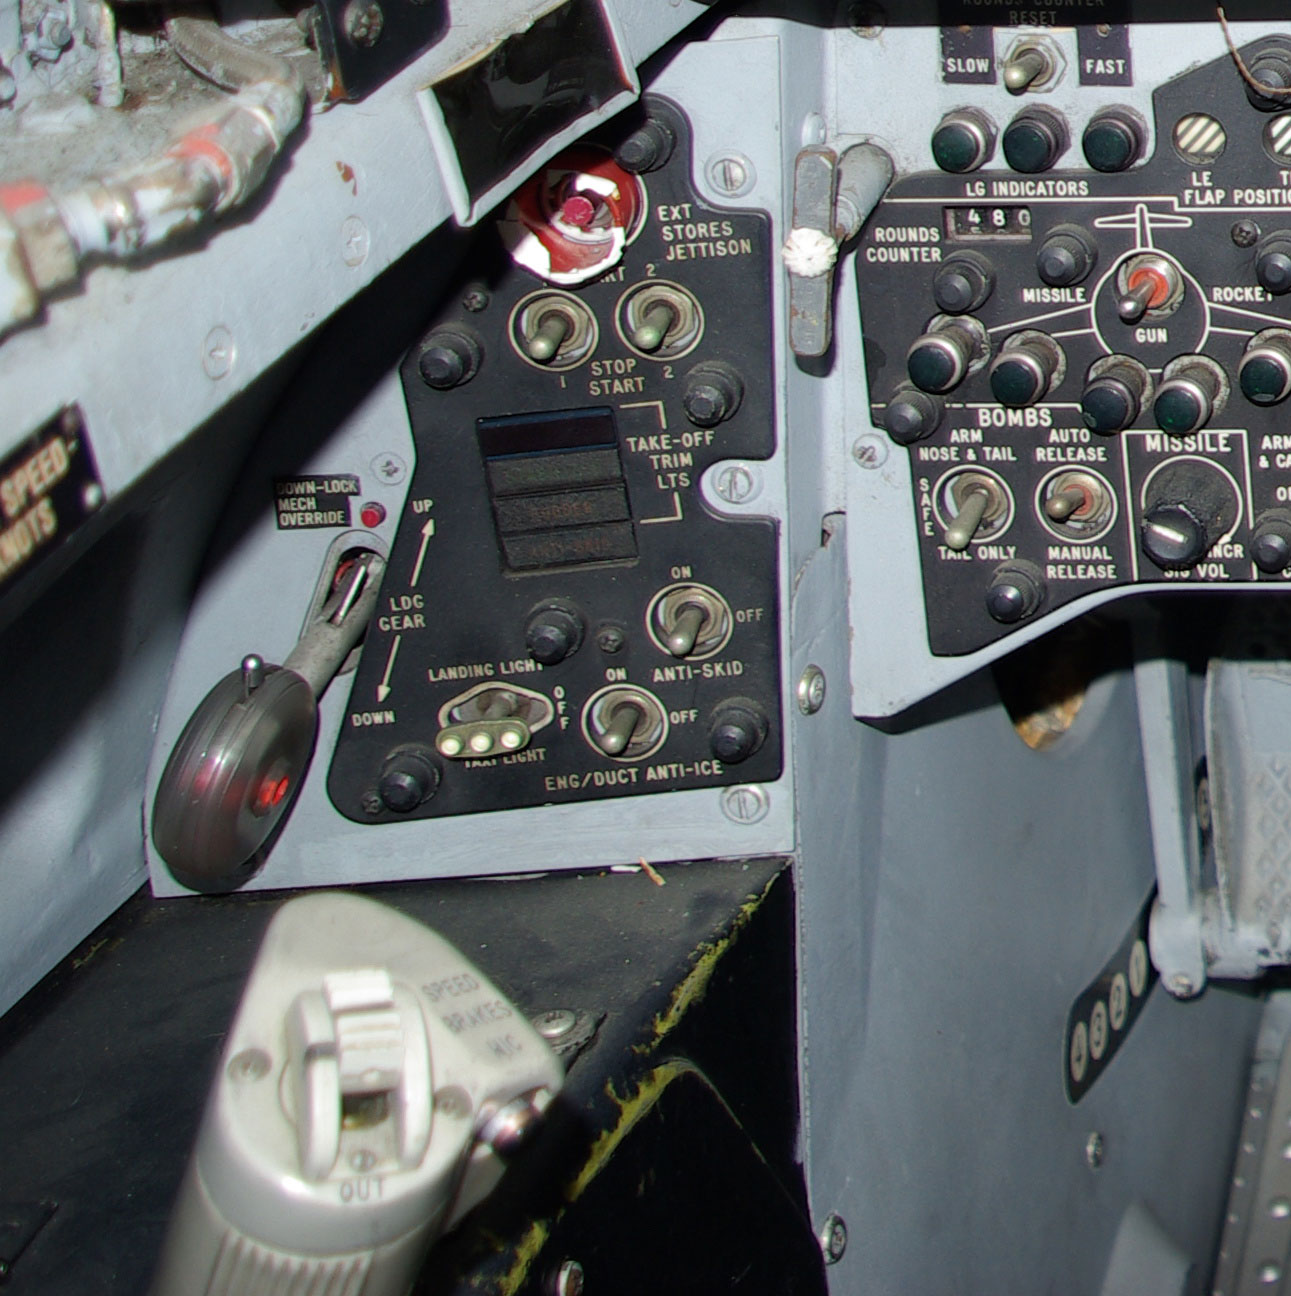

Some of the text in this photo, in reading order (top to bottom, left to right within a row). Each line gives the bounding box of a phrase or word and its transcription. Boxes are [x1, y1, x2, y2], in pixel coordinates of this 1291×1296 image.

[947, 58, 989, 74] SLOW
[1085, 59, 1125, 74] FAST
[657, 204, 692, 222] EXT
[662, 220, 733, 241] STORES
[875, 227, 940, 242] ROUNDS
[666, 238, 752, 262] JETTISON
[866, 247, 942, 263] COUNTER
[1135, 328, 1168, 343] GUN
[591, 358, 636, 377] STOP
[588, 377, 645, 396] START
[978, 408, 1053, 428] BOMBS
[626, 430, 715, 453] TAKE-OFF
[950, 429, 983, 444] ARM
[649, 452, 693, 471] TRIM
[919, 447, 1017, 462] NOSE & TAIL
[656, 472, 691, 491] LTS
[278, 497, 316, 511] MECH
[413, 498, 434, 513] UP
[919, 478, 934, 536] SAFE
[278, 508, 346, 525] OVERRIDE
[977, 546, 1017, 560] ONLY
[1048, 546, 1113, 560] MANUAL
[671, 565, 692, 580] ON
[1046, 565, 1117, 579] RELEASE
[1197, 564, 1230, 578] VOL
[390, 594, 425, 610] LDG
[379, 613, 426, 632] GEAR
[736, 608, 765, 622] OFF
[605, 666, 627, 681] ON
[653, 659, 744, 683] ANTI-SKID
[352, 709, 395, 727] DOWN
[670, 709, 698, 725] OFF
